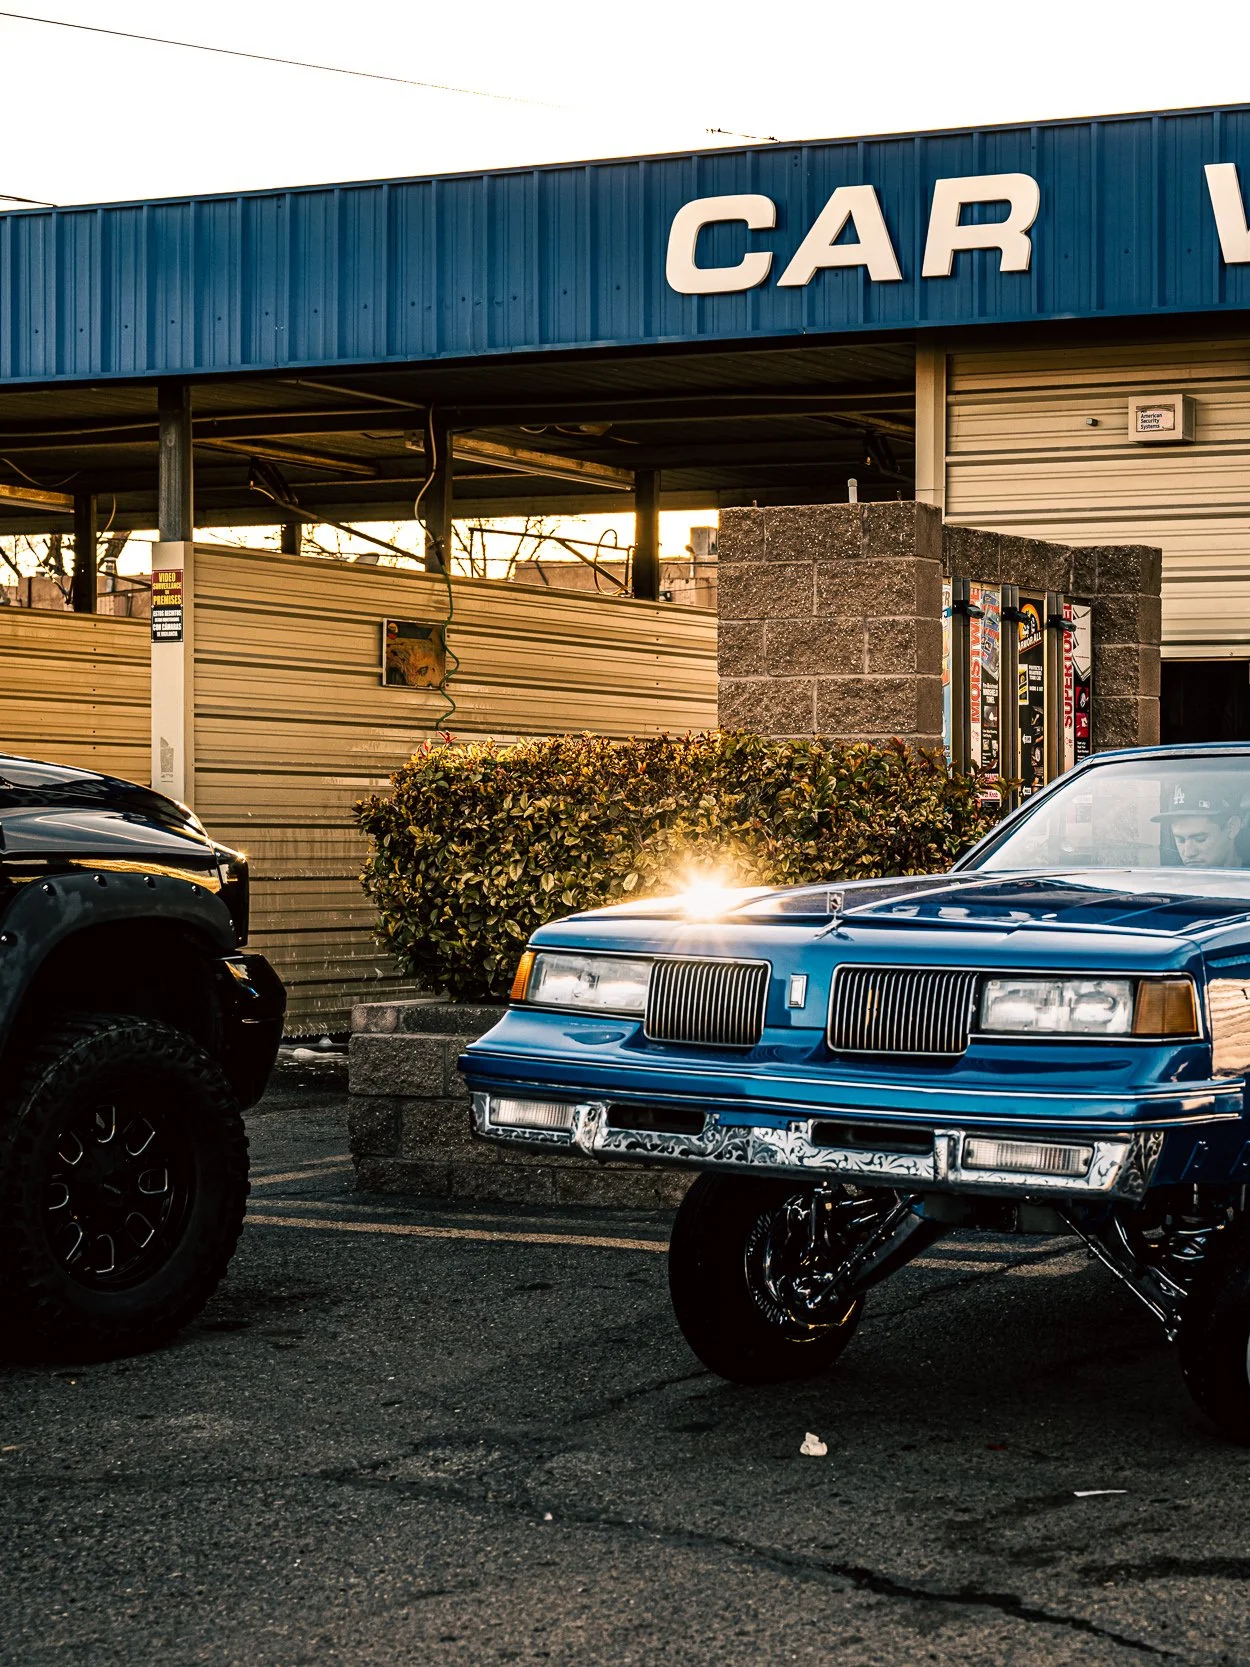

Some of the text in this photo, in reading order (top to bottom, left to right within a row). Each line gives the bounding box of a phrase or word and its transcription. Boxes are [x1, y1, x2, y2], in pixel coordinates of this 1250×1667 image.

[665, 172, 1041, 296] CAR
[159, 572, 176, 582] VIDEO
[154, 595, 182, 605] PREMISES
